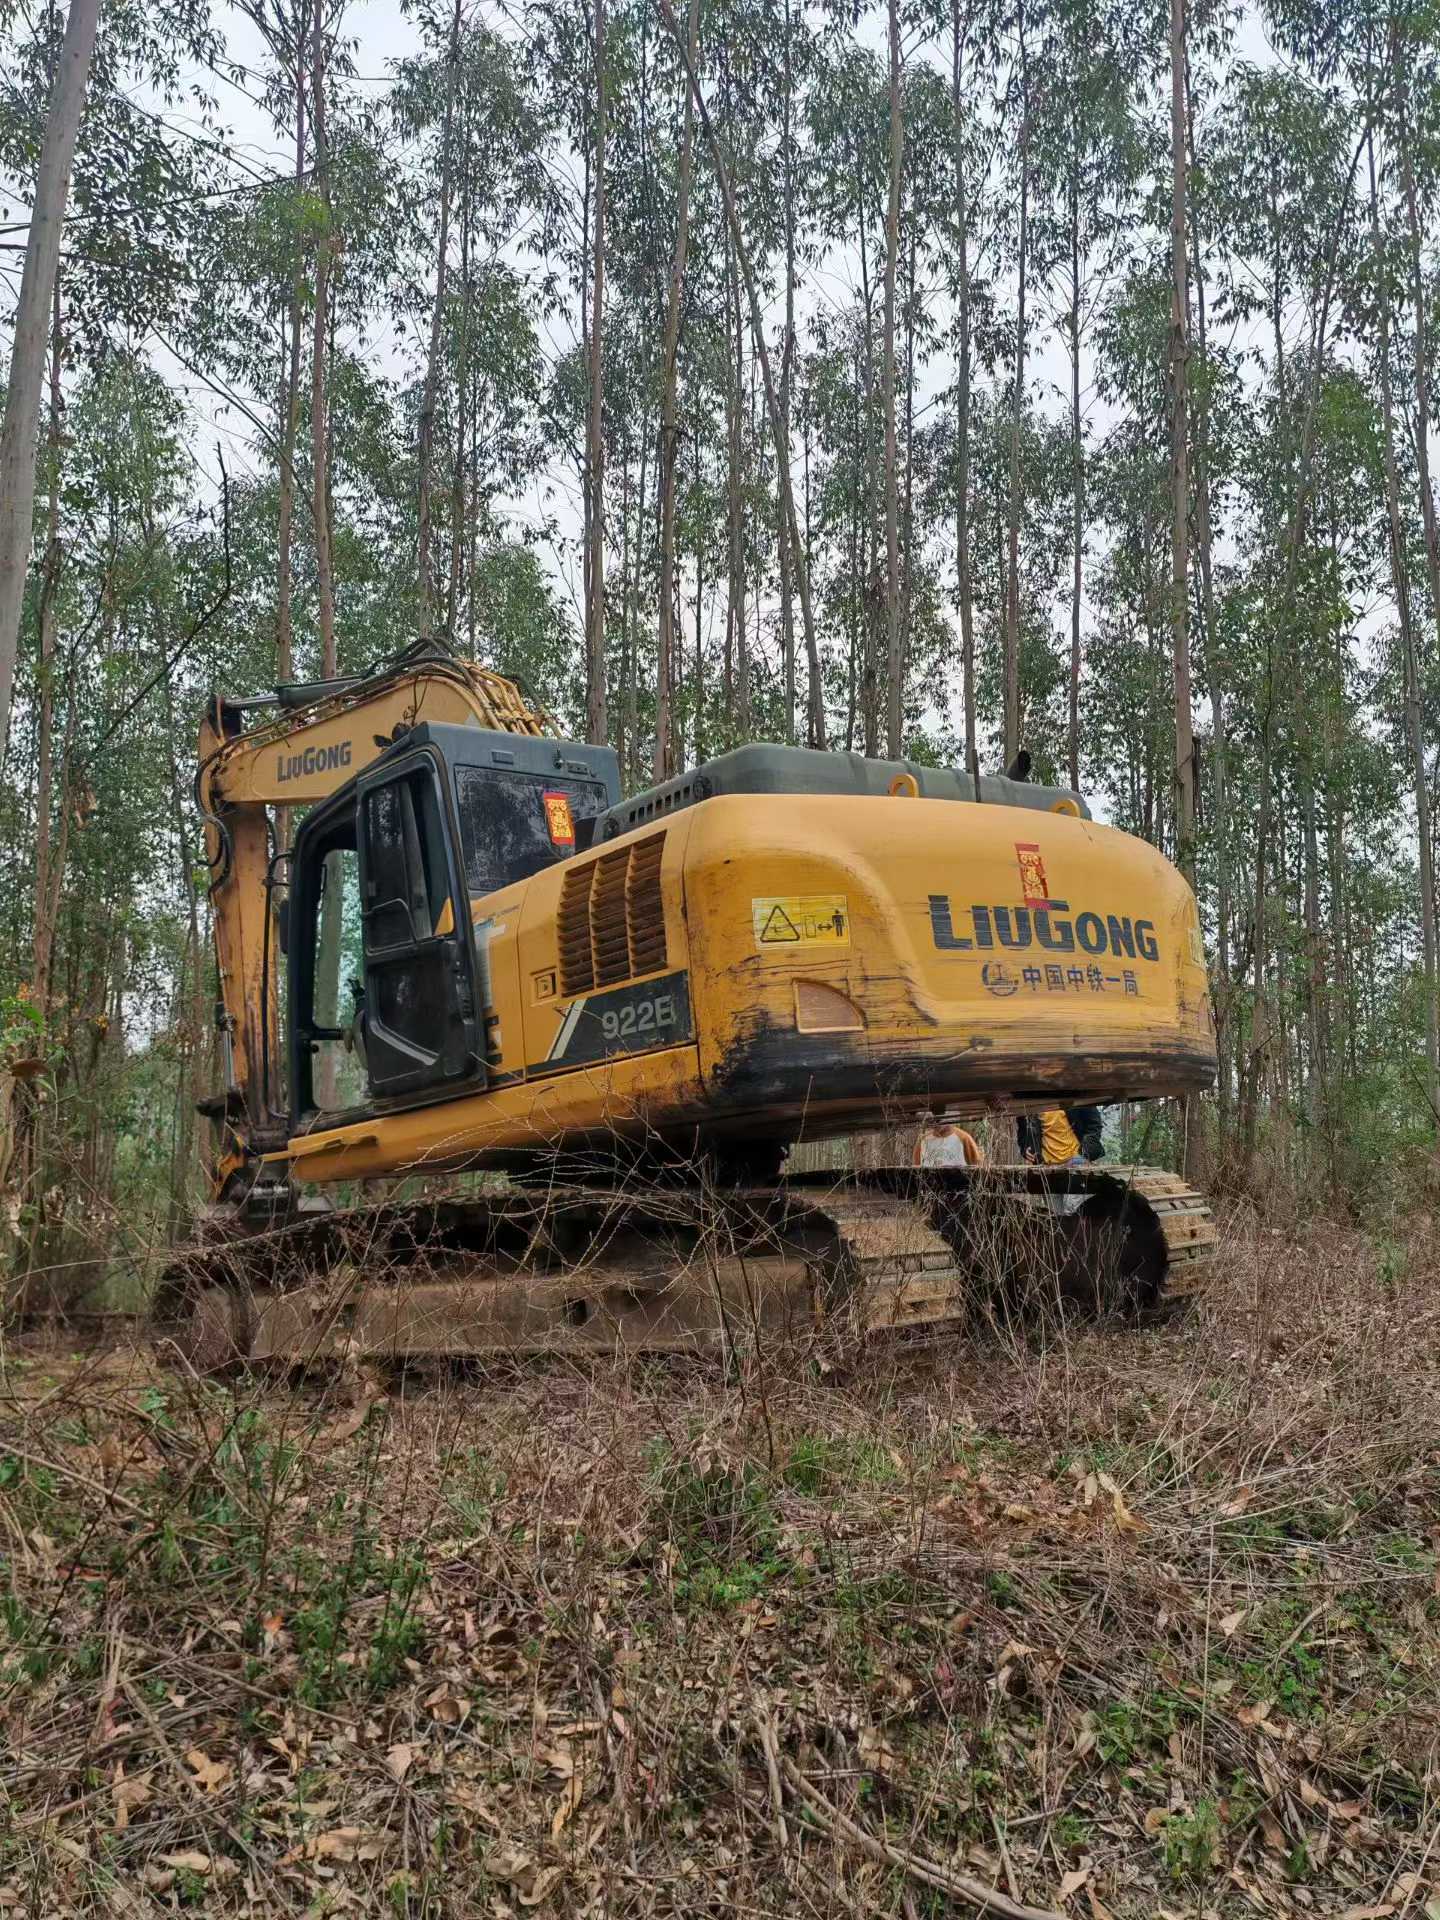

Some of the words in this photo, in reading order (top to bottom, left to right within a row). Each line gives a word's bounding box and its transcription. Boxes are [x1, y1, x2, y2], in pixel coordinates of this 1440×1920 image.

[1022, 963, 1139, 997] 中国中铁一局
[601, 995, 676, 1040] 922E
